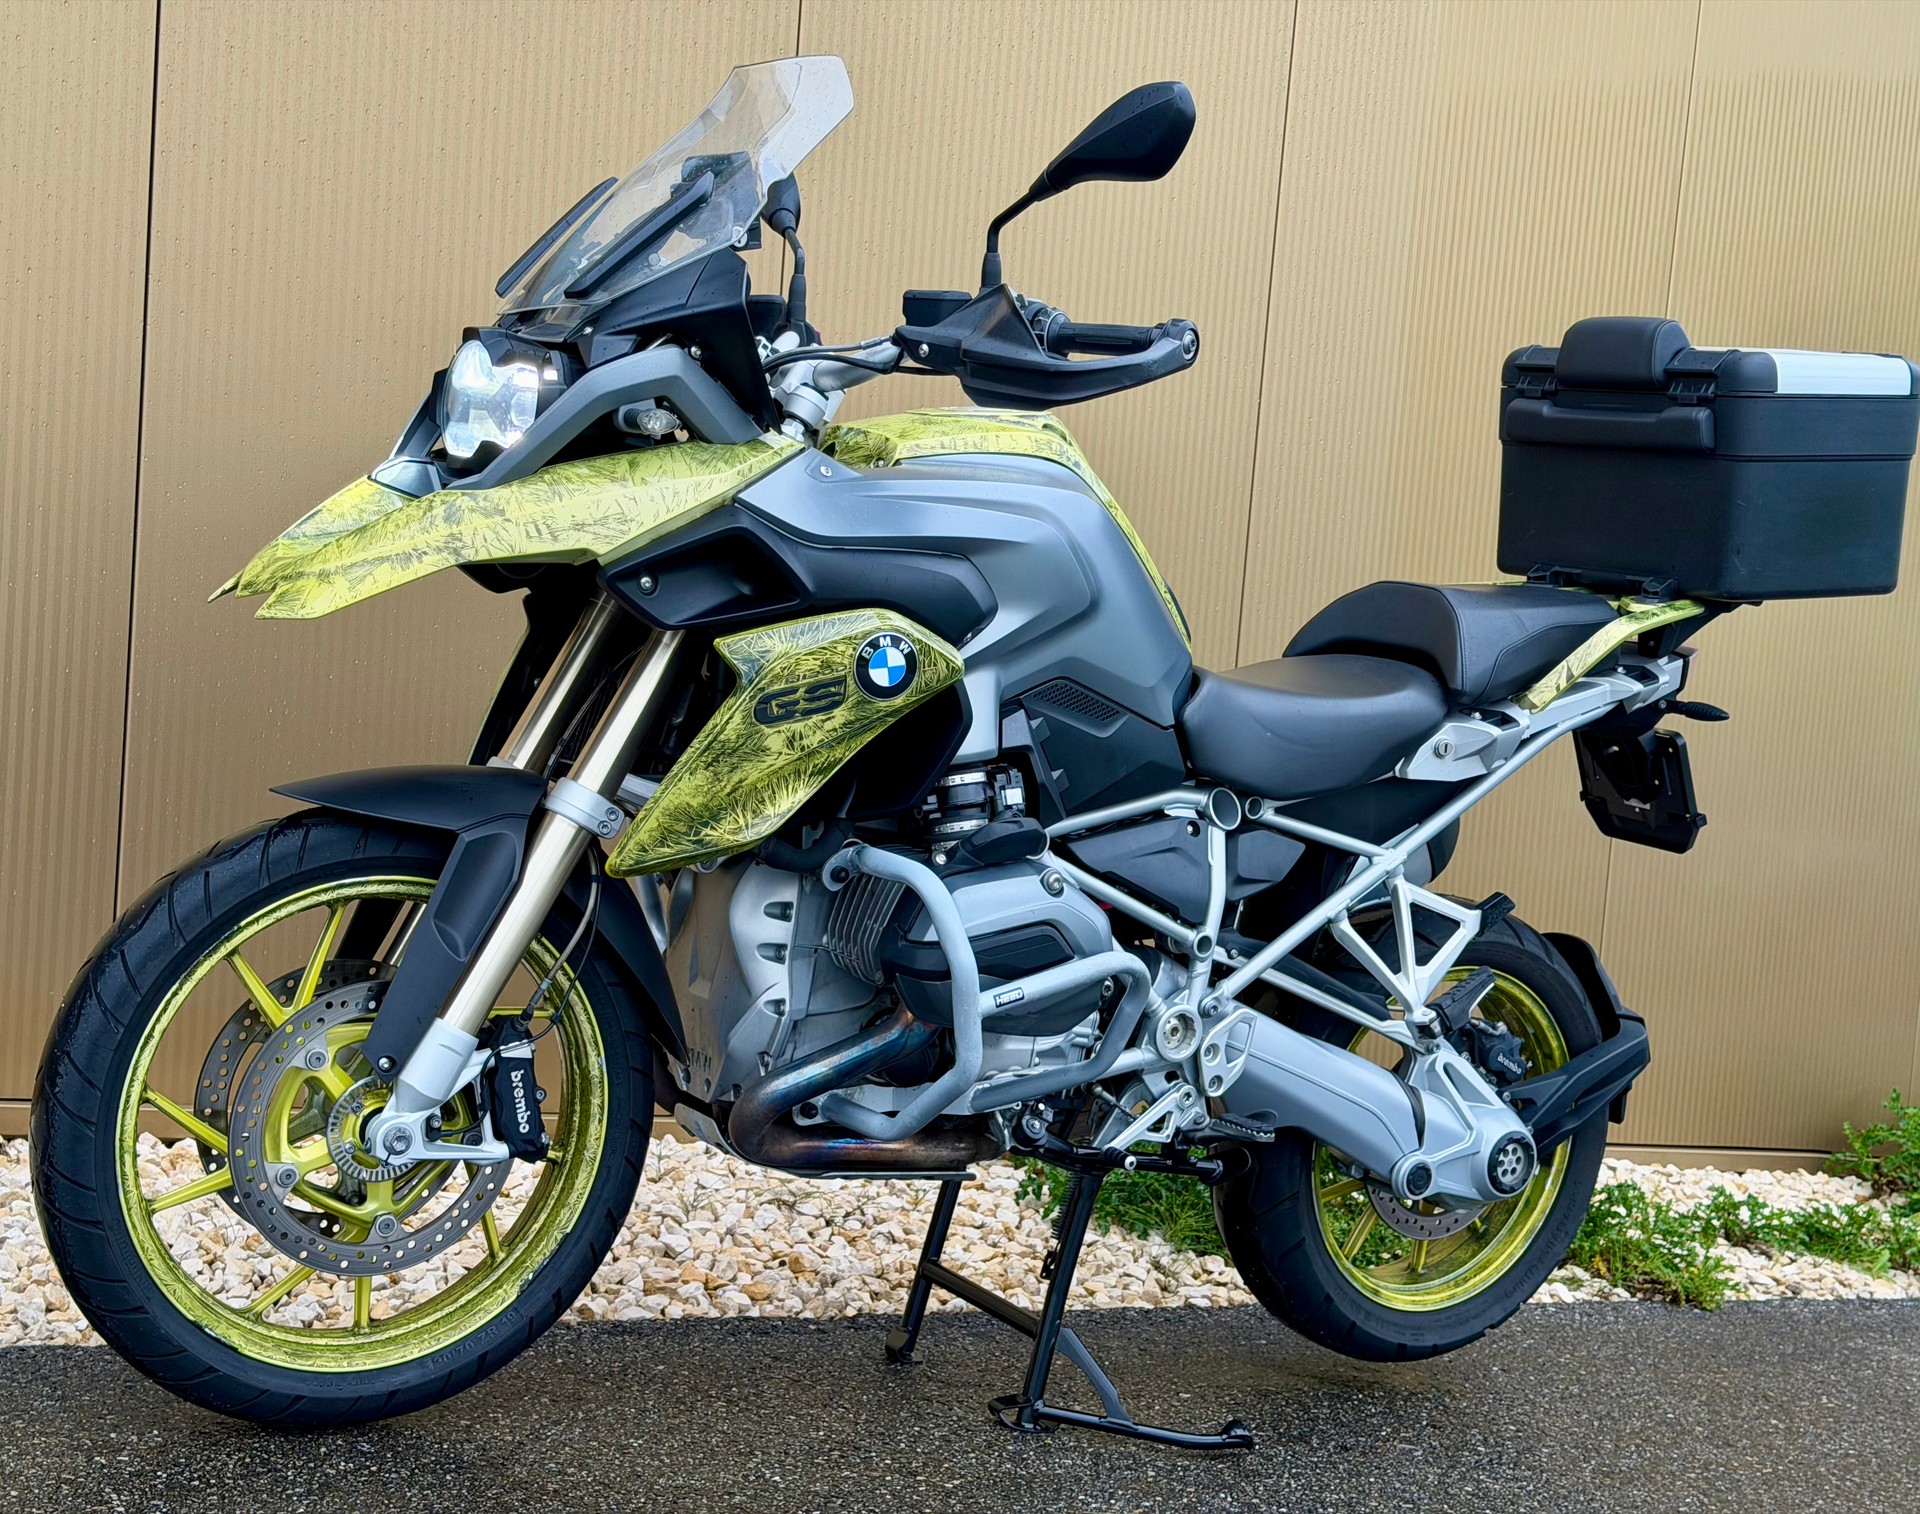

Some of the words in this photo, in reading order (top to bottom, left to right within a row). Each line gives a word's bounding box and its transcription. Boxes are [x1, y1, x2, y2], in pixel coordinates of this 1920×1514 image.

[861, 635, 912, 660] BMW
[753, 676, 847, 725] GS
[1497, 1052, 1522, 1075] brembo
[510, 1069, 531, 1134] brembo
